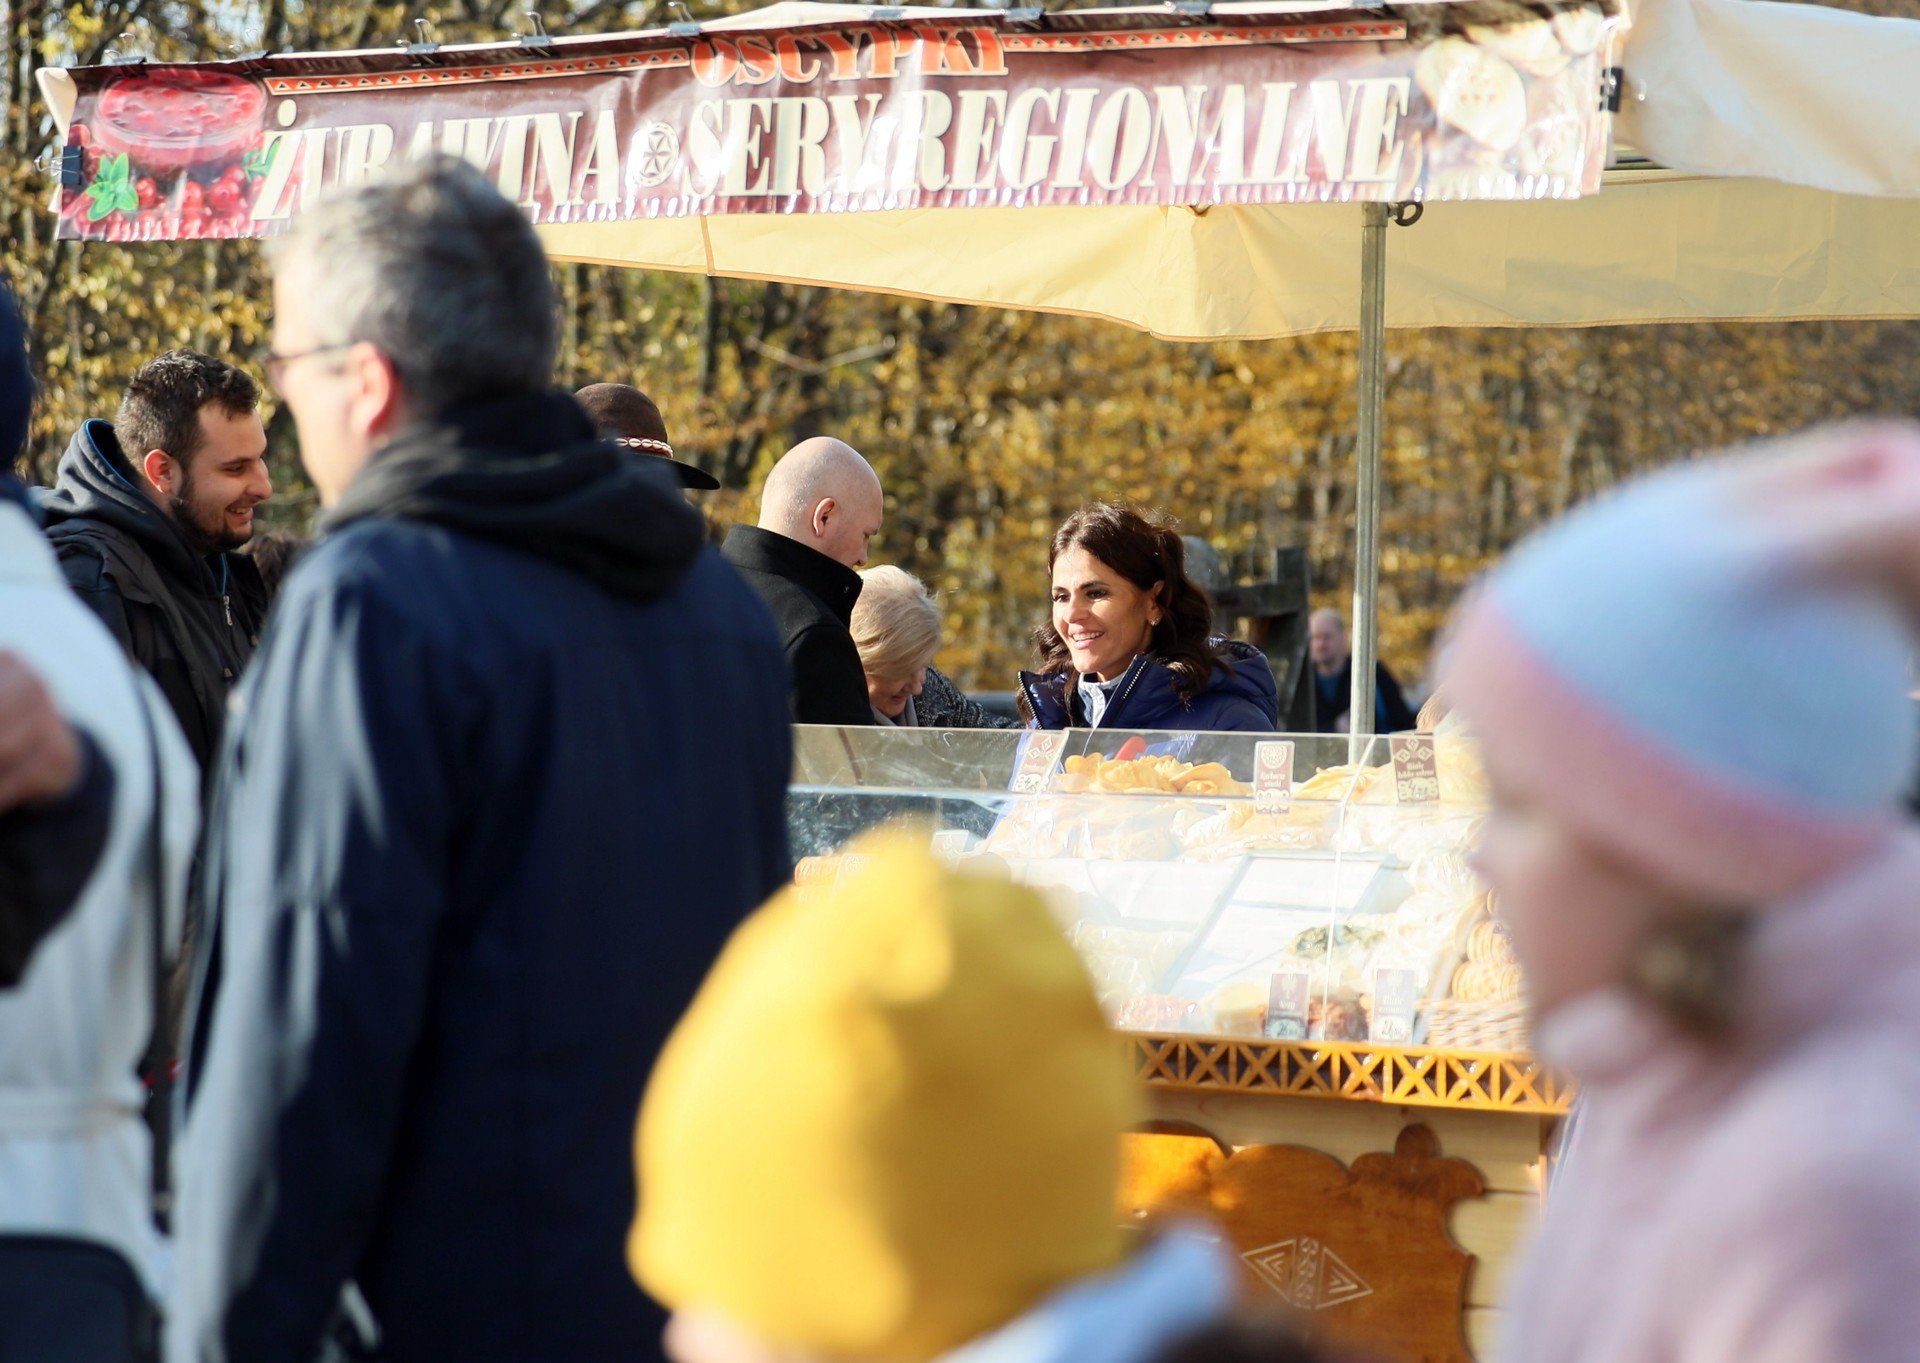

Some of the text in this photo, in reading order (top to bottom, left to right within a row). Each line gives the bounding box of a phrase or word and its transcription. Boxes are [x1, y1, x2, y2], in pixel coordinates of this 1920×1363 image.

[691, 26, 1009, 87] OSCYPKI
[679, 93, 883, 199] SERY
[892, 77, 1411, 192] REGIONALNE
